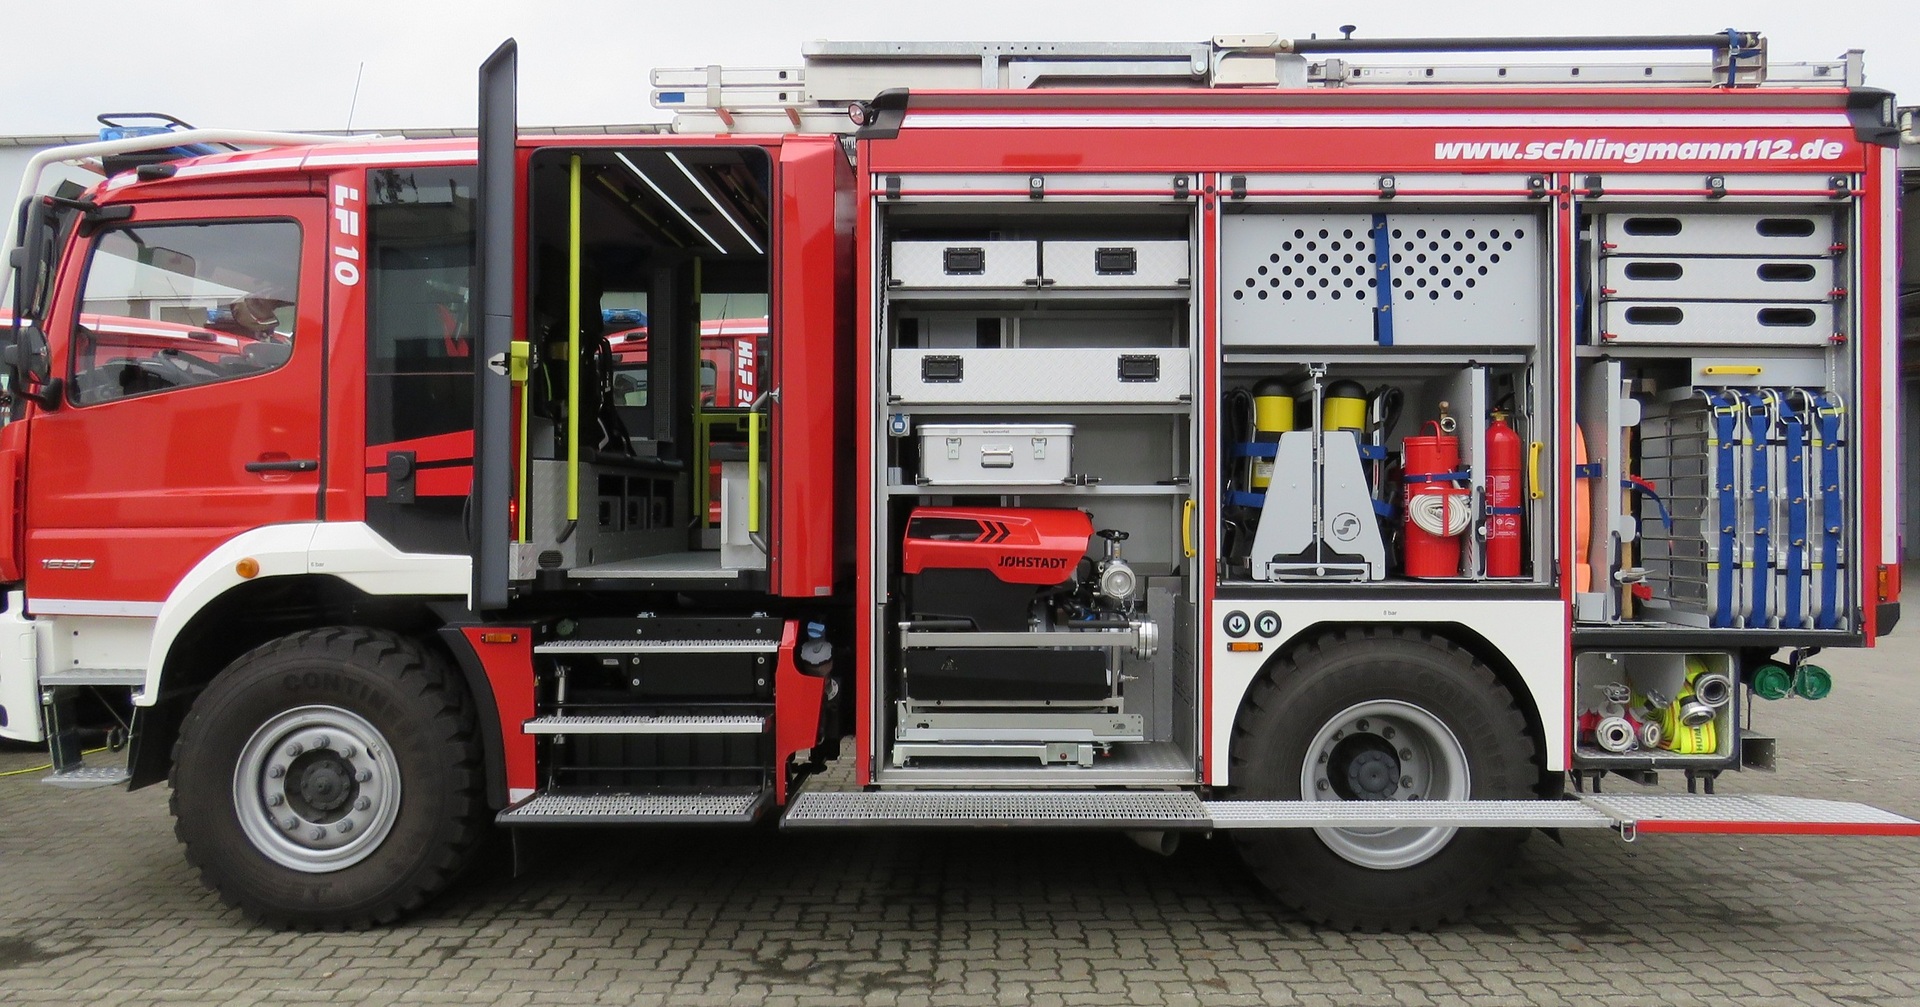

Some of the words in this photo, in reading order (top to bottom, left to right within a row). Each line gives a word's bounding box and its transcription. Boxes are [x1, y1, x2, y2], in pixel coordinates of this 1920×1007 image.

[1434, 138, 1843, 163] www.schlingmann112.de
[335, 185, 359, 236] LF
[335, 246, 359, 286] 10
[738, 340, 753, 386] HLF
[41, 558, 95, 570] 1830
